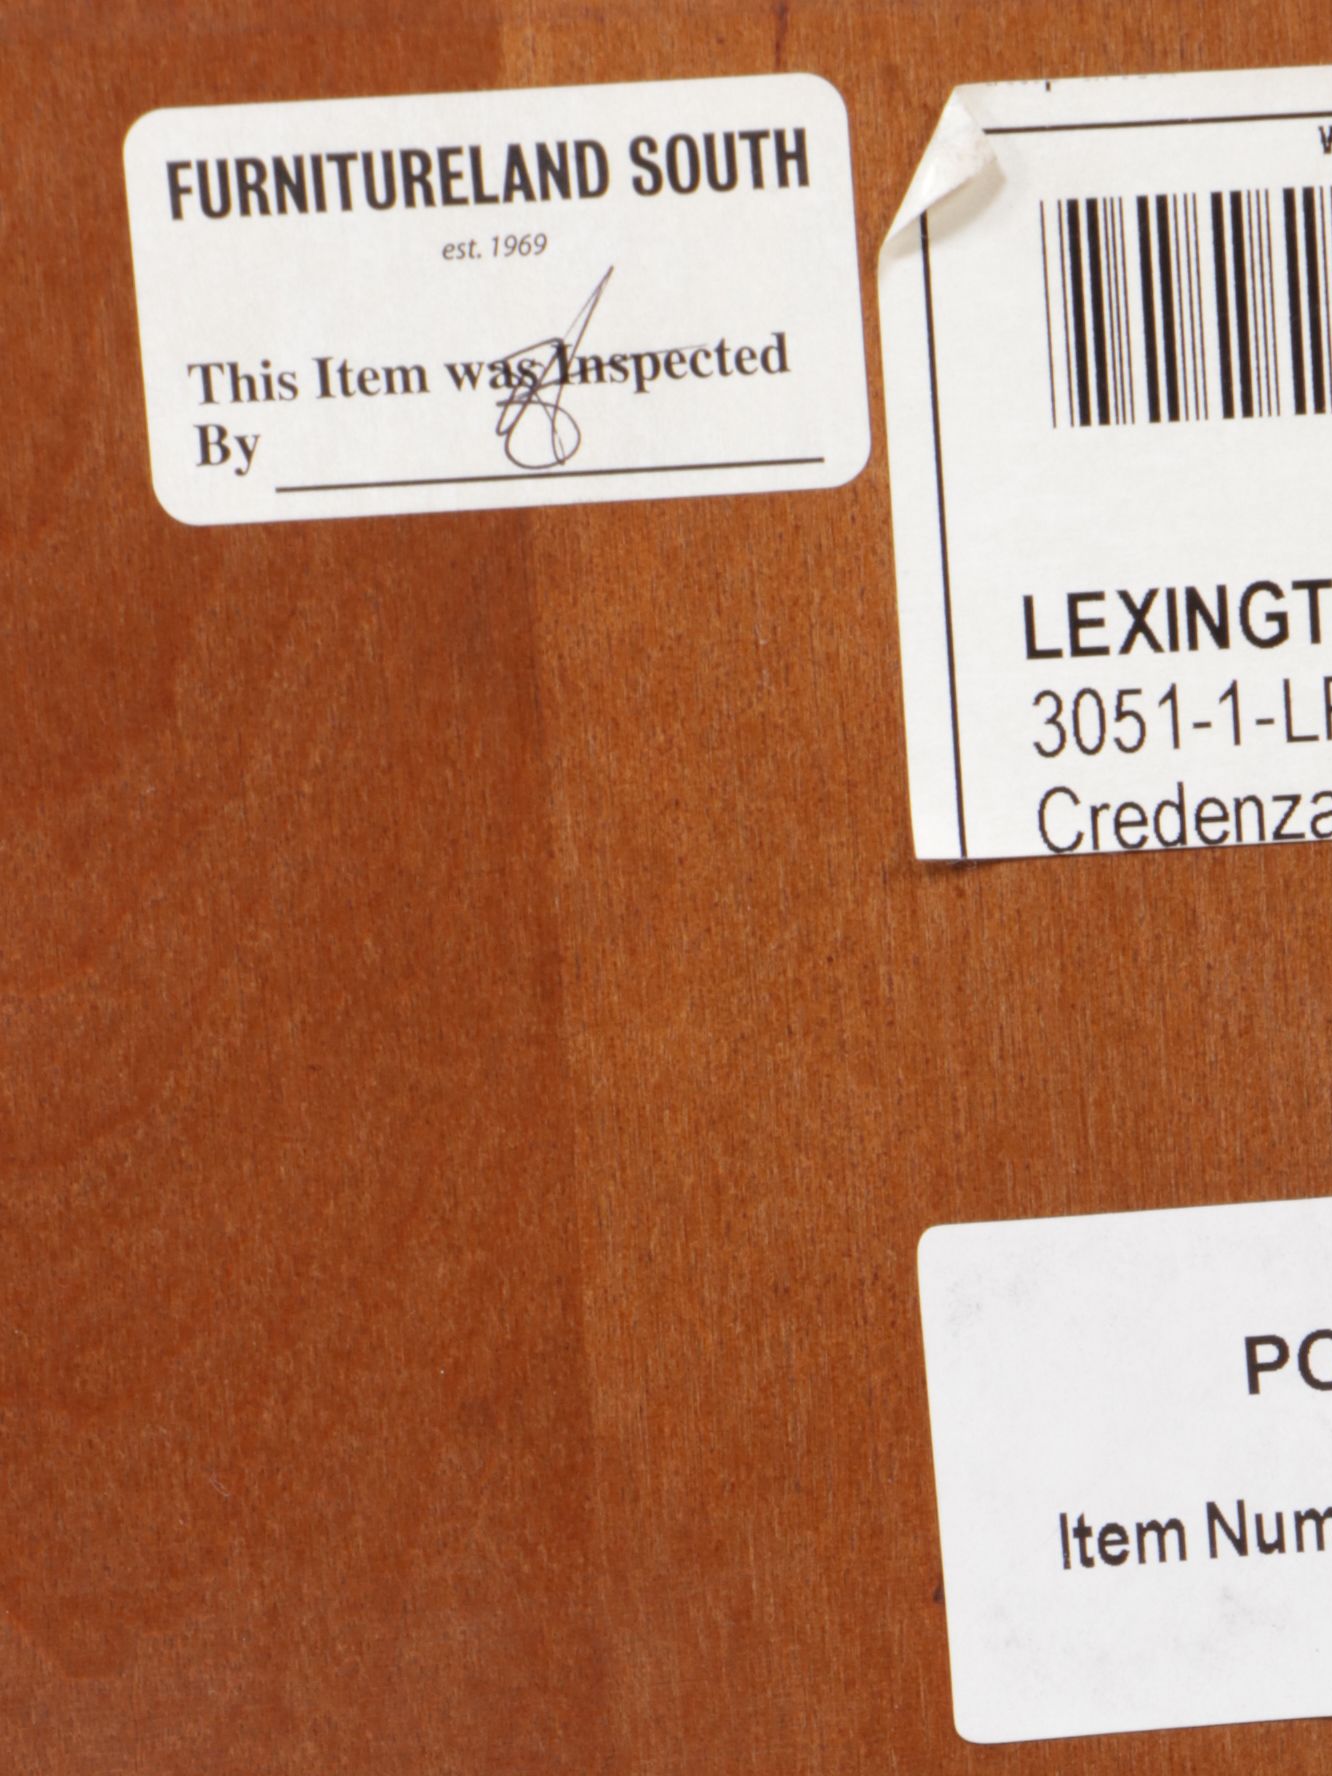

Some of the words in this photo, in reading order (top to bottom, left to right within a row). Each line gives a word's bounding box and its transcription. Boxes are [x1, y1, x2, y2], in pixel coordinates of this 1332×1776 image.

[166, 139, 610, 221] FURNITURELAND
[628, 127, 810, 197] SOUTH
[441, 238, 483, 261] est.
[493, 233, 548, 257] 1969
[187, 359, 299, 405] This
[314, 356, 430, 399] Item
[445, 357, 540, 393] was
[552, 331, 792, 393] Inspected
[195, 424, 260, 477] By
[1059, 1512, 1188, 1571] Item
